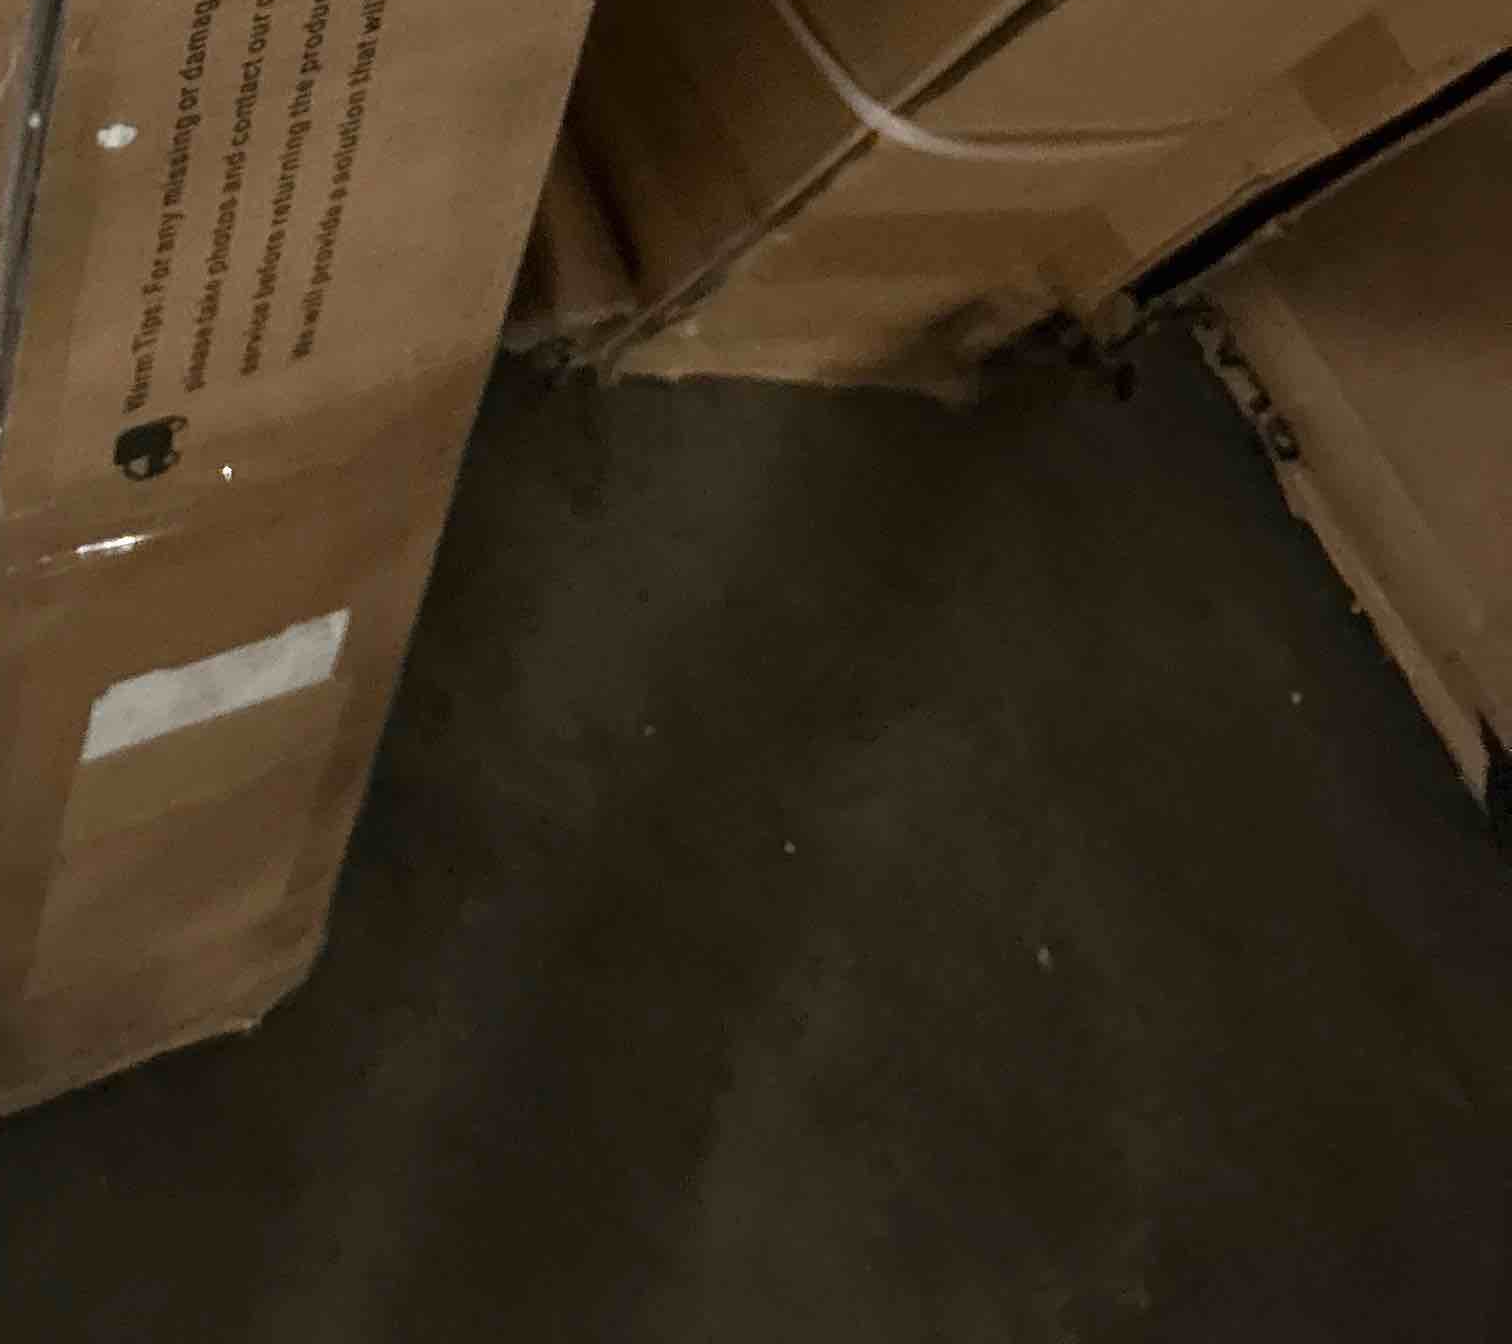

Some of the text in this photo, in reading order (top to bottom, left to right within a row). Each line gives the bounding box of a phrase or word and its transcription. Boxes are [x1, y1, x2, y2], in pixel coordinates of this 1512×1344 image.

[247, 13, 271, 53] our
[348, 38, 378, 86] that
[177, 87, 199, 110] or
[230, 56, 263, 145] contact
[288, 79, 314, 117] the
[162, 115, 201, 206] missing
[332, 91, 366, 184] solution
[221, 152, 247, 192] and
[271, 120, 312, 225] returning
[329, 188, 348, 199] a
[155, 213, 184, 252] any
[206, 198, 237, 274] photos
[310, 206, 343, 285] provide
[140, 259, 170, 295] For
[253, 230, 285, 298] before
[196, 280, 221, 324] take
[303, 289, 324, 326] will
[240, 302, 270, 375] service
[122, 355, 154, 413] Warm
